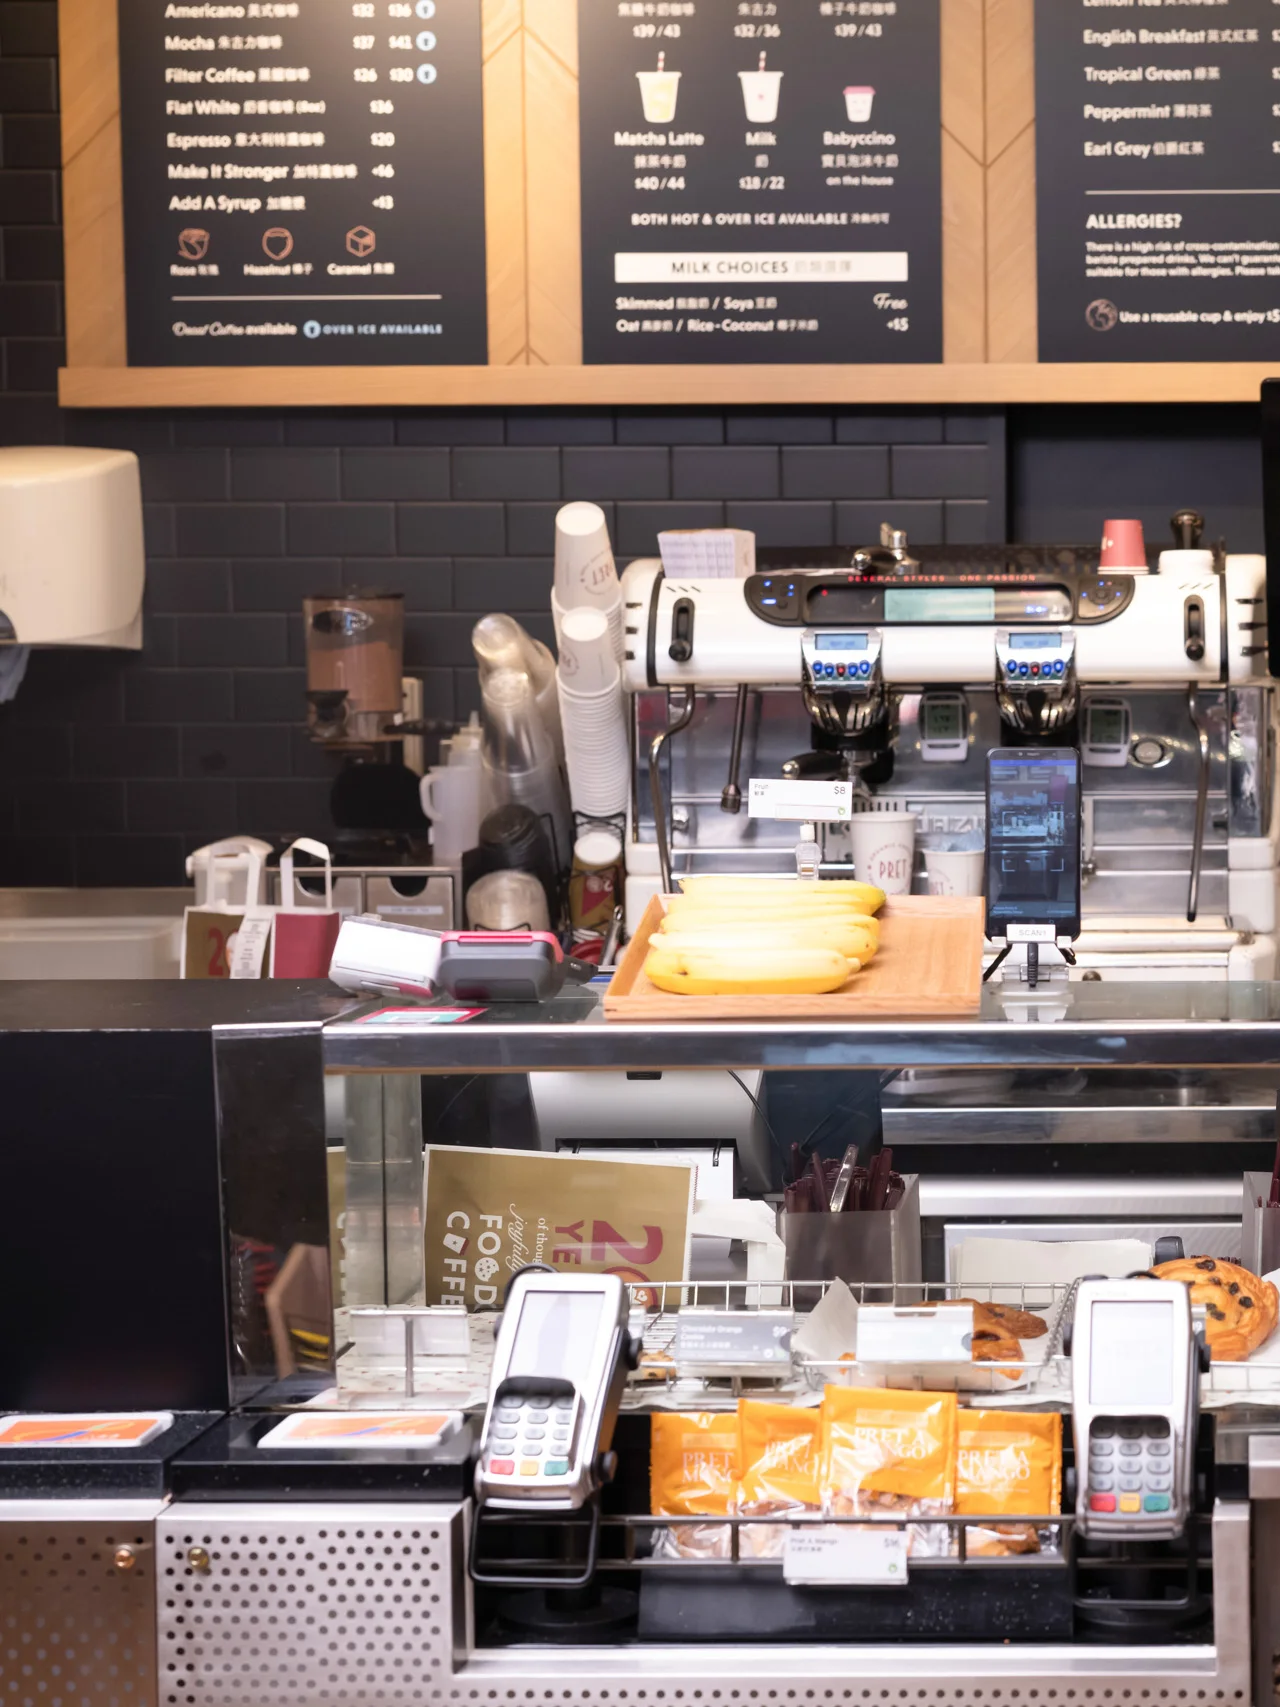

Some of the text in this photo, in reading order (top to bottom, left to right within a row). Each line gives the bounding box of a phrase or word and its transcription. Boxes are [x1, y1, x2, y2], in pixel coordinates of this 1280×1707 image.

[165, 4, 245, 18] Americano
[165, 36, 215, 50] Mocha
[1083, 29, 1136, 47] English
[1139, 29, 1206, 44] Breakfast
[165, 68, 203, 82] Filter
[205, 68, 256, 82] Coffee
[1084, 66, 1143, 85] Tropical
[1145, 66, 1192, 81] Green
[166, 100, 194, 115] Flat
[195, 100, 240, 115] White
[1083, 104, 1171, 122] Peppermint
[167, 133, 231, 150] Espresso
[614, 132, 705, 146] Matcha Latte
[745, 132, 777, 146] Milk
[823, 131, 896, 149] Babyccino
[1084, 142, 1112, 156] Earl
[1114, 141, 1151, 159] Grey
[168, 164, 289, 182] Make It Stronger
[861, 175, 894, 185] house
[169, 196, 262, 213] Add A Syrup
[631, 213, 668, 226] BOTH
[671, 213, 700, 226] HOT
[702, 213, 713, 226] &
[715, 213, 751, 225] OVER
[754, 213, 776, 225] ICE
[778, 213, 848, 225] AVAILABLE
[1086, 214, 1182, 229] ALLERGIES?
[327, 264, 371, 276] Caramel
[672, 261, 710, 274] MILK
[716, 261, 789, 273] CHOICES
[615, 297, 674, 310] Skimmed
[723, 297, 754, 312] Soya
[1119, 311, 1141, 322] Use
[1141, 313, 1150, 322] a
[1151, 310, 1199, 322] reusable
[1200, 312, 1222, 324] cup
[1234, 309, 1265, 324] enjoy
[323, 323, 443, 335] OVER ICE AVAILABLE
[616, 319, 640, 332] Oat
[687, 319, 774, 332] Rice-Coconut
[848, 574, 1036, 583] SEVERAL STYLES ONE PASSION
[834, 786, 846, 795] $8
[880, 859, 907, 879] PRET
[682, 1452, 735, 1469] PRET
